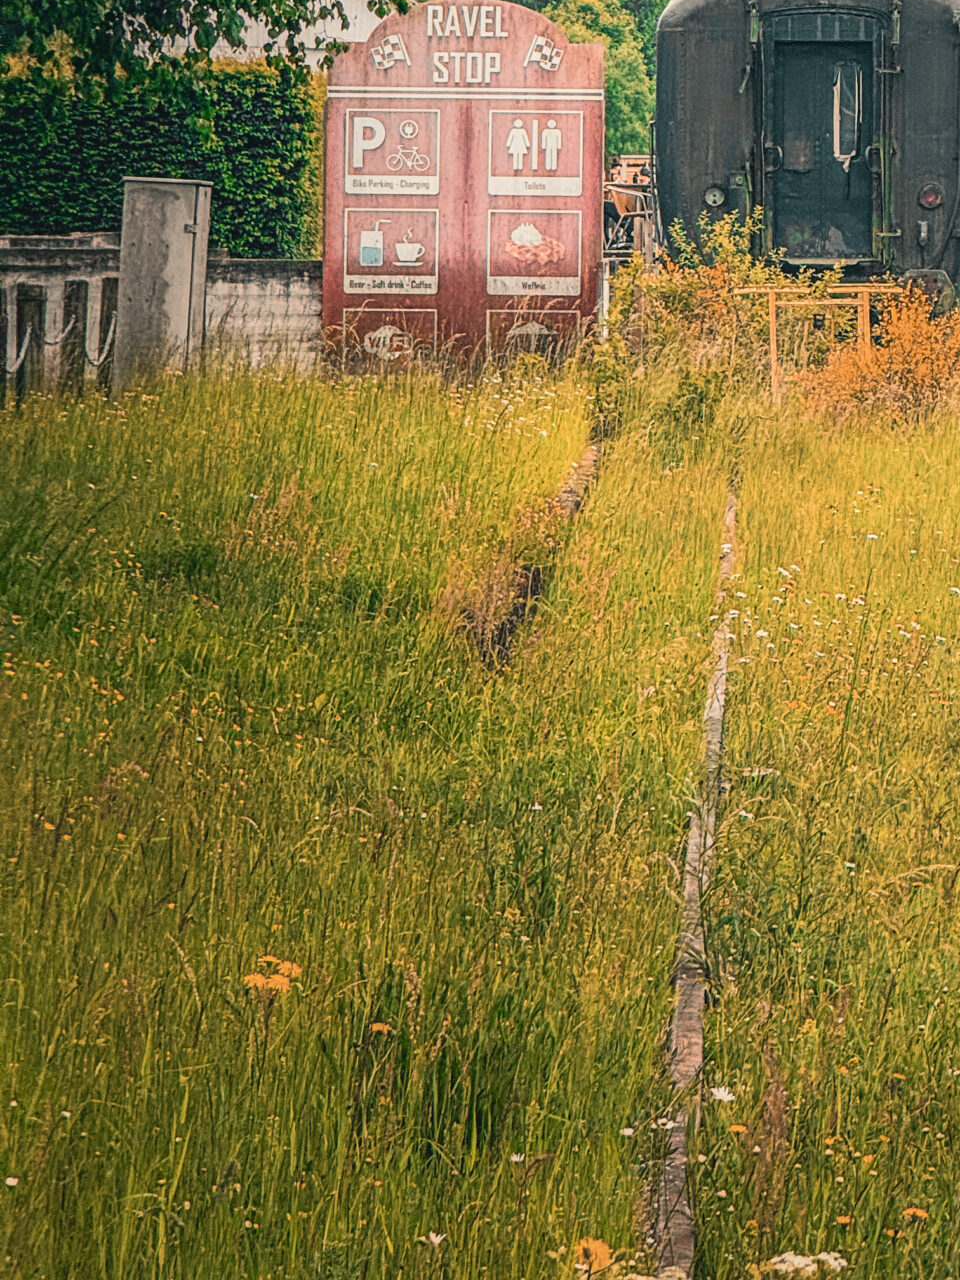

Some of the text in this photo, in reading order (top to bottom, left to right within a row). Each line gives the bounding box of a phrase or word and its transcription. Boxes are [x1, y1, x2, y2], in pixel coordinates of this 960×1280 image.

[427, 5, 508, 37] RAVEL
[433, 52, 500, 83] STOP
[353, 116, 386, 168] P
[352, 179, 367, 188] Bike
[369, 179, 394, 190] Parking
[400, 179, 430, 190] Charging
[524, 181, 546, 190] Toilets
[349, 280, 366, 289] Beer
[372, 280, 386, 289] Soft
[387, 280, 405, 289] drink
[410, 280, 433, 289] Coffee
